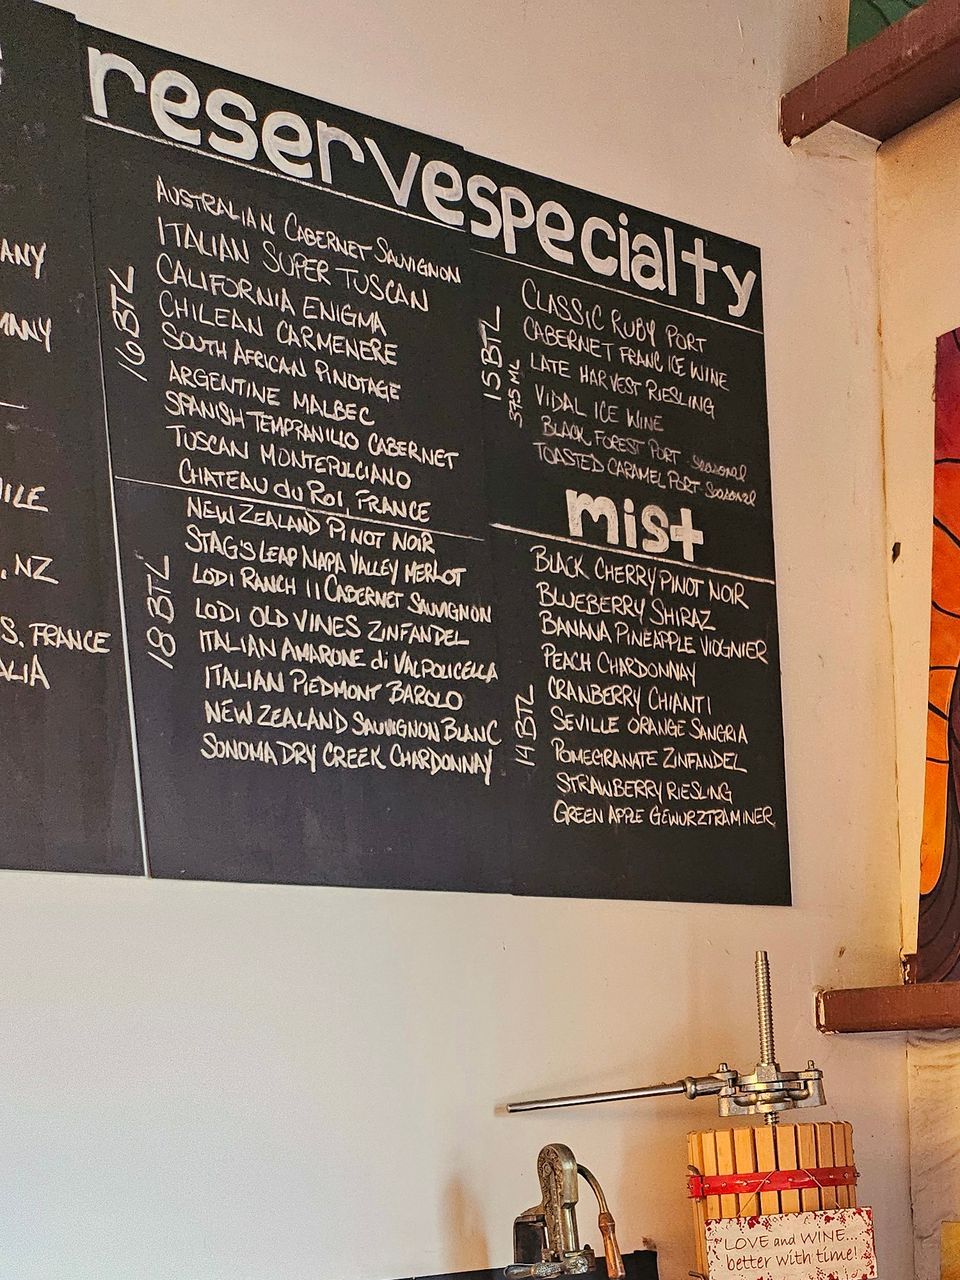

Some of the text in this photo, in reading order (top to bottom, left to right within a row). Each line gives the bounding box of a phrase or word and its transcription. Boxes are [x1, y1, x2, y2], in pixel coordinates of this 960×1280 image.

[87, 46, 464, 226] reserve
[156, 175, 276, 235] AUSTRALIAN
[284, 212, 373, 262] CABERNET
[157, 216, 429, 313] ITALIAN SUPER TUSCAN
[466, 174, 757, 318] specialty
[156, 252, 387, 337] CALIFORNIA ENIGMA
[521, 278, 707, 354] CLASSIC RUBY PORT
[159, 290, 399, 366] CHILEAN CARMENERE
[523, 315, 730, 391] CABERNET FRANC ICE WINE
[162, 321, 401, 403] SOUTH AFRICAN PINOTAGE
[530, 352, 716, 421] LATE HARVEST RIESLING
[168, 360, 376, 426] ARGENTINE MALBEC
[535, 384, 664, 432] VIDAL ICE WINE
[164, 390, 246, 429] SPANISH
[368, 432, 460, 470] CABERNET
[165, 425, 249, 460] TUSCAN
[540, 415, 592, 447] BLACK
[594, 430, 645, 456] FOREST
[648, 438, 681, 465] PORT
[179, 457, 268, 495] CHATEAU
[355, 489, 432, 523] FRANCE
[533, 441, 604, 473] TOASTED
[608, 458, 666, 489] CARAMEL
[667, 470, 700, 494] PORT
[187, 496, 436, 554] NEW ZEALAND PINOT NOIR
[565, 488, 704, 562] mist
[192, 562, 235, 588] LODI
[240, 566, 297, 596] RANCH
[302, 545, 346, 575] NAPA
[350, 549, 399, 586] VALLEY
[404, 559, 467, 587] MERLOT
[530, 545, 749, 609] BLACK CHERRY PINOT NOIR
[195, 597, 470, 646] LODI OLD VINES ZINFANDEL
[536, 581, 716, 631] BLUEBERRY SHIRAZ
[28, 623, 112, 653] FRANCE
[199, 629, 277, 660] ITALIAN
[371, 650, 389, 671] di
[538, 609, 613, 645] BANANA
[614, 621, 696, 654] PINEAPPLE
[204, 663, 463, 711] ITALIAN PIEDMONT BAROLO
[541, 642, 696, 687] PEACH CHARDONNAY
[548, 675, 712, 715] CRANBERRY CHIANTI
[204, 698, 252, 725] NEW
[257, 704, 348, 735] ZEALAND
[440, 716, 503, 746] BLANC
[551, 705, 748, 744] SEVILLE ORANGE SANGRIA
[200, 732, 494, 786] SONOMA DRY CREEK CHARDONNAY
[551, 737, 747, 773] POMEGRANATE ZINFANDEL
[553, 799, 603, 825] GREEN
[608, 804, 645, 824] APPLE
[556, 772, 733, 805] STRAWBERRY RIESLING
[724, 1235, 769, 1250] LOVE
[773, 1233, 795, 1247] and
[725, 1246, 859, 1271] better with time!
